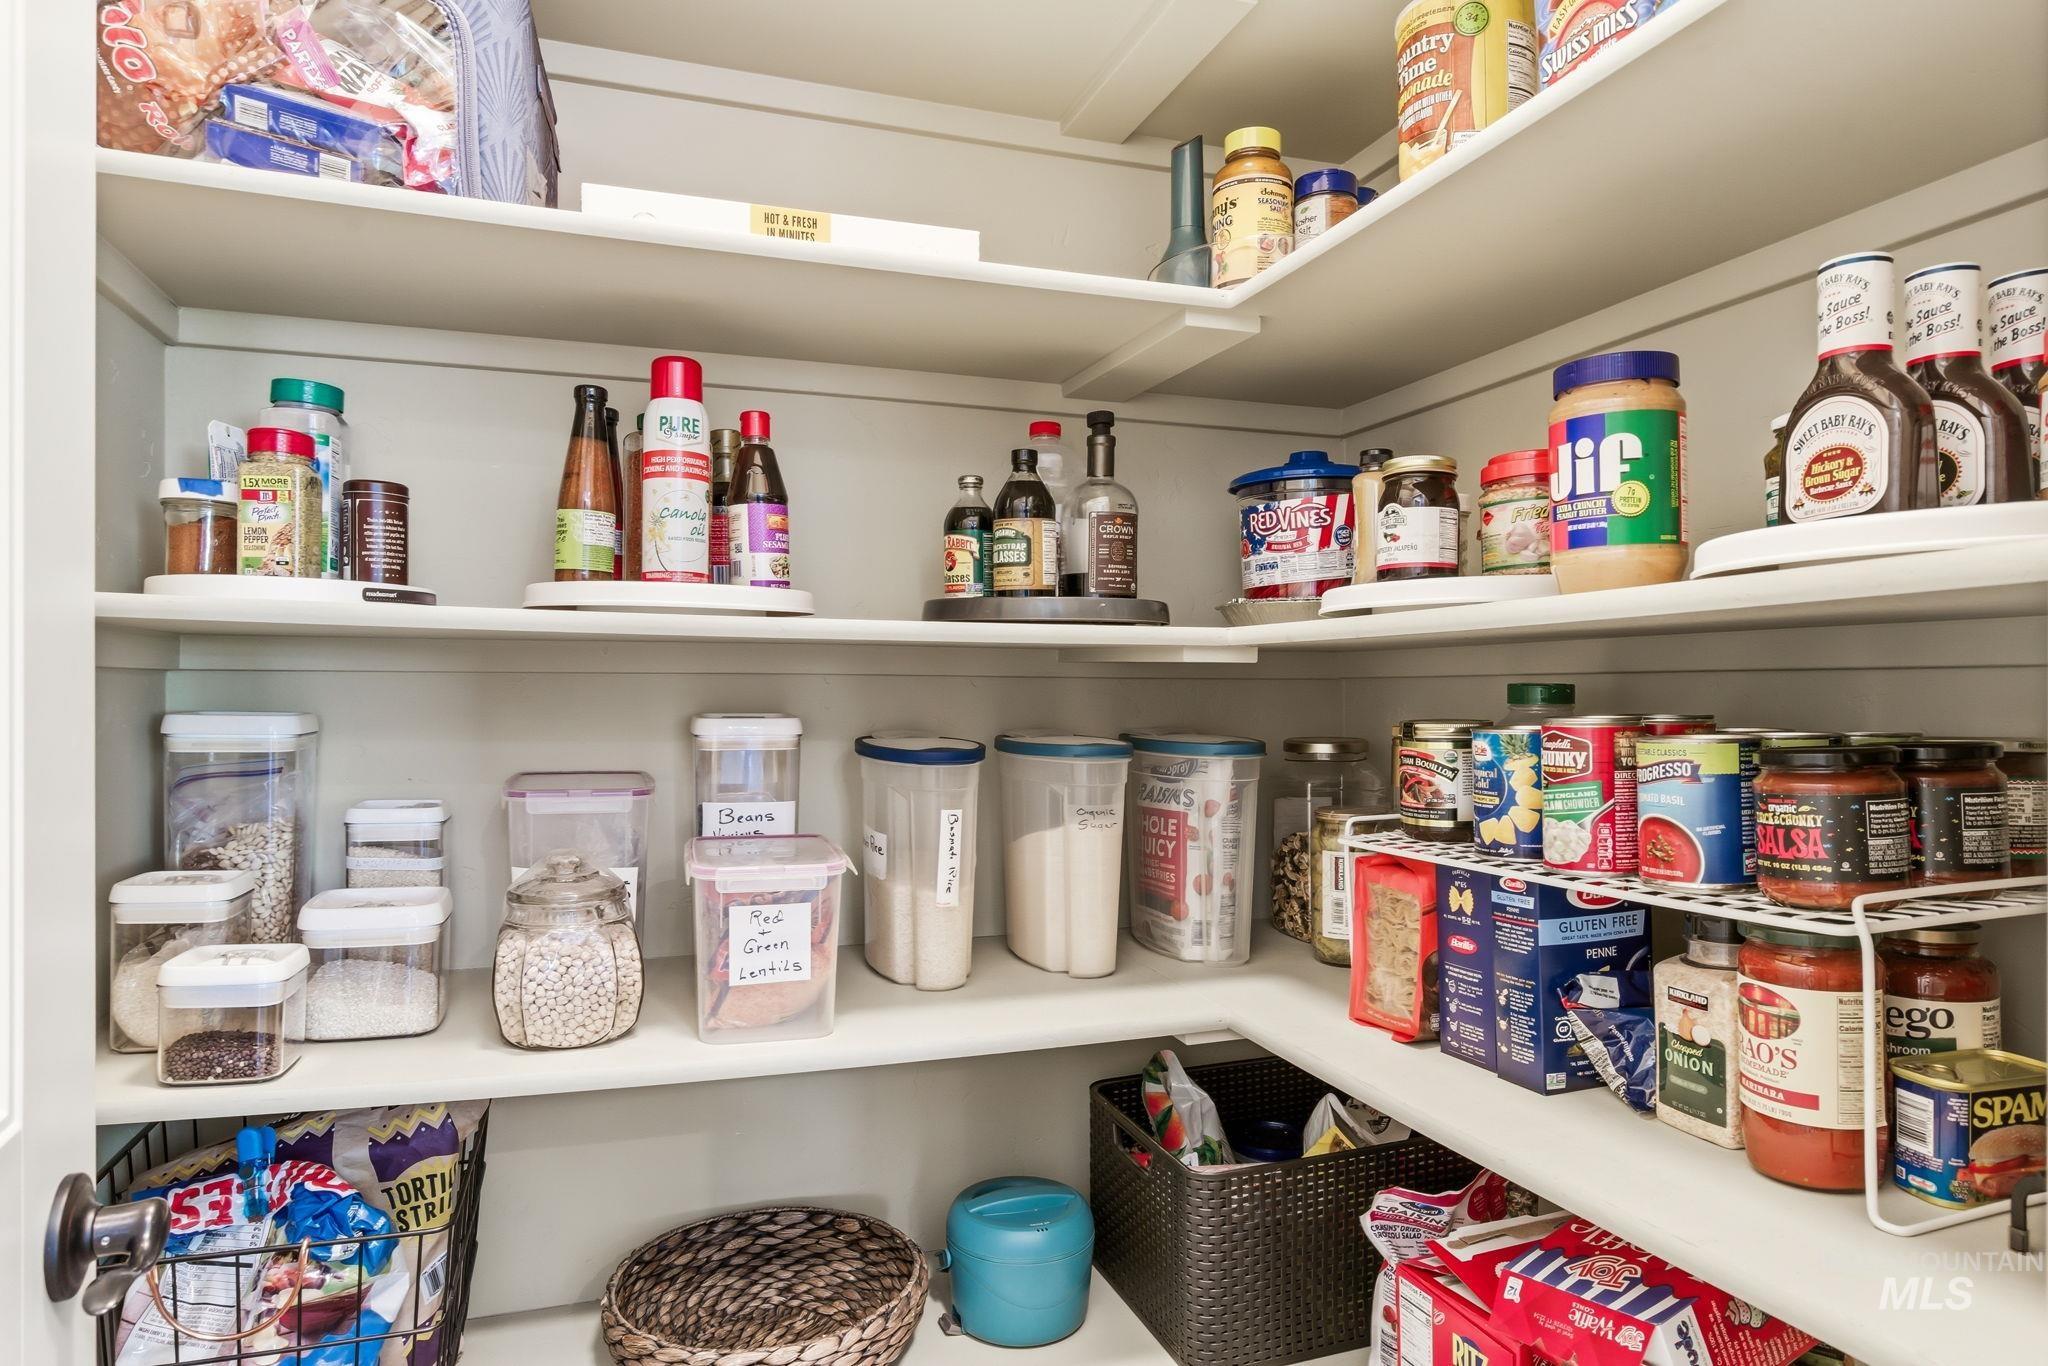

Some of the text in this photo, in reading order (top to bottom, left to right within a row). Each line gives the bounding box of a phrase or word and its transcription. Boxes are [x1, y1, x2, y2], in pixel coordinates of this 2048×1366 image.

[1465, 12, 1479, 22] 34
[1541, 28, 1592, 84] SWISS
[764, 212, 818, 229] HOT & FRESH
[766, 227, 816, 242] IN MINUTES
[1825, 273, 1871, 291] BABY RAY'S
[1913, 282, 1962, 299] BABY RAY'S
[1996, 285, 2045, 304] BABY RAY'S
[1826, 292, 1862, 317] Sauce
[1915, 301, 1953, 325] Sauce
[1835, 305, 1871, 330] Boss!
[1926, 313, 1962, 337] Boss!
[2000, 305, 2037, 330] Sauce
[2011, 317, 2047, 341] Boss!
[659, 415, 700, 434] PURE
[1939, 418, 1971, 441] RAY'S
[1793, 414, 1877, 455] SWEET BABY RAY'S
[1550, 432, 1643, 503] Jif
[1811, 456, 1854, 475] Hickory &
[1804, 466, 1861, 488] Brown Sugar
[1628, 486, 1636, 496] 7g
[1572, 499, 1607, 511] CRUNCHY
[1578, 507, 1607, 518] BUTTER
[659, 507, 707, 522] canola
[1250, 506, 1331, 534] RED VINES
[243, 526, 267, 535] LEMON
[690, 523, 706, 537] oil
[1099, 524, 1134, 535] CROWN
[243, 535, 269, 544] PEPPER
[947, 536, 974, 550] RABBIT
[1656, 749, 1688, 757] CLASSICS
[1415, 758, 1456, 780] BOUILLON
[1555, 790, 1598, 799] ENGLAND
[1659, 794, 1686, 806] BASIL
[1563, 797, 1601, 810] CHOWDER
[1767, 803, 1798, 816] organic
[1869, 803, 1897, 811] Nutrition
[718, 807, 776, 825] Beans
[1076, 807, 1116, 821] Organic
[1779, 813, 1824, 827] CHUNKY
[1756, 825, 1831, 861] SALSA
[1811, 864, 1833, 873] 454g
[1504, 879, 1526, 890] Barilla
[749, 909, 785, 927] Red
[1558, 914, 1638, 934] GLUTEN FREE
[742, 938, 790, 955] Green
[1450, 938, 1477, 951] Barilla
[1586, 945, 1618, 959] PENNE
[1668, 987, 1708, 1005] KIRKLAND
[1559, 1025, 1569, 1033] GF
[1671, 1039, 1703, 1057] Chopped
[1664, 1048, 1714, 1077] ONION
[1973, 1090, 2048, 1128] SPAM
[1375, 1205, 1451, 1227] CRAISINS
[1400, 1225, 1421, 1233] DRIED
[1506, 1284, 1516, 1294] 12
[1571, 1301, 1595, 1315] CONES
[1567, 1308, 1616, 1340] Waffle
